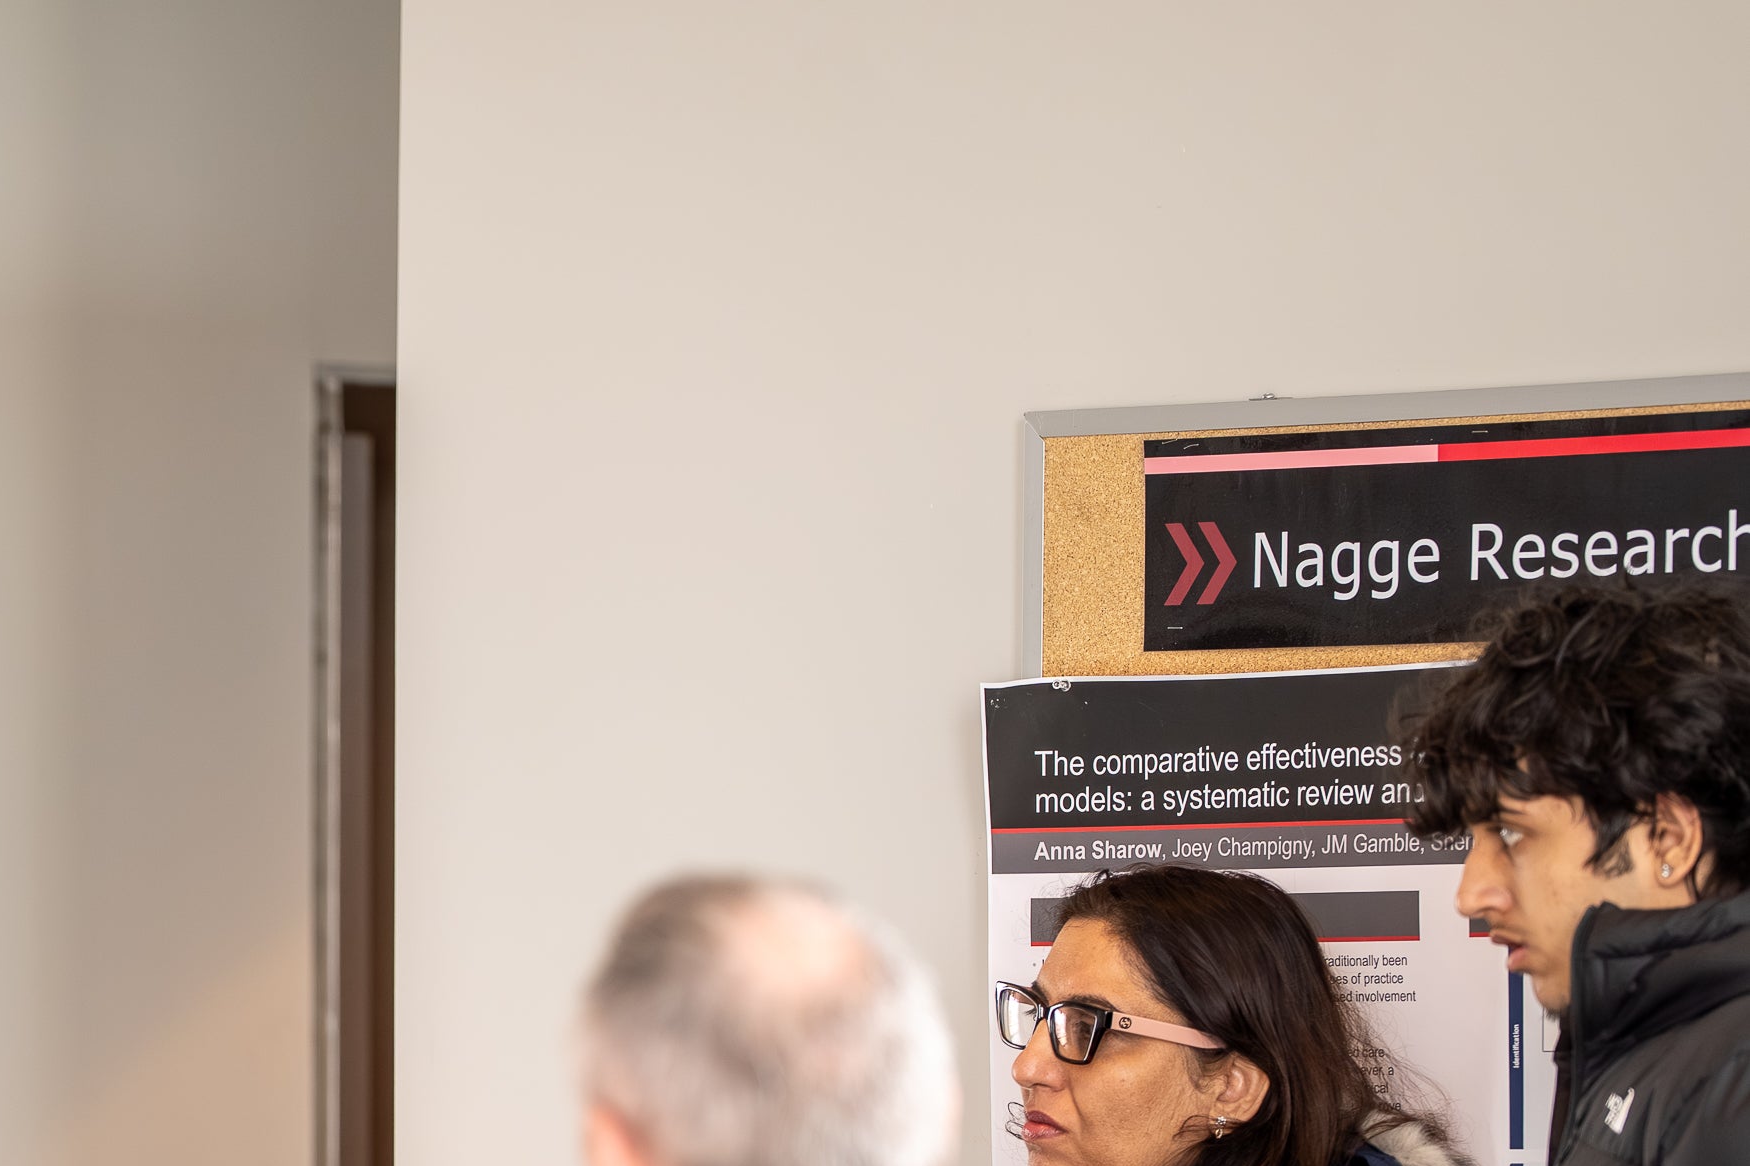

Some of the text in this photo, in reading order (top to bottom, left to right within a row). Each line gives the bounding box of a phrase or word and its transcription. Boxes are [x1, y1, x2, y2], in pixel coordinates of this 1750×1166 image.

[1253, 509, 1750, 601] Nagge Research
[1034, 750, 1085, 777] The
[1092, 745, 1239, 780] comparative
[1246, 742, 1402, 771] effectiveness
[1034, 785, 1133, 813] models:
[1140, 789, 1156, 811] a
[1162, 780, 1290, 816] systematic
[1296, 779, 1374, 806] review
[1034, 842, 1087, 862] Anna
[1091, 839, 1166, 862] Sharow,
[1172, 838, 1215, 860] Joey
[1217, 834, 1316, 860] Champigny,
[1321, 834, 1348, 855] JM
[1353, 831, 1425, 855] Gamble,
[1324, 955, 1408, 969] raditionally been
[1351, 972, 1362, 985] of
[1363, 972, 1404, 987] practice
[1355, 990, 1417, 1003] involvement
[1361, 1048, 1385, 1058] care
[1512, 1024, 1520, 1069] Identification
